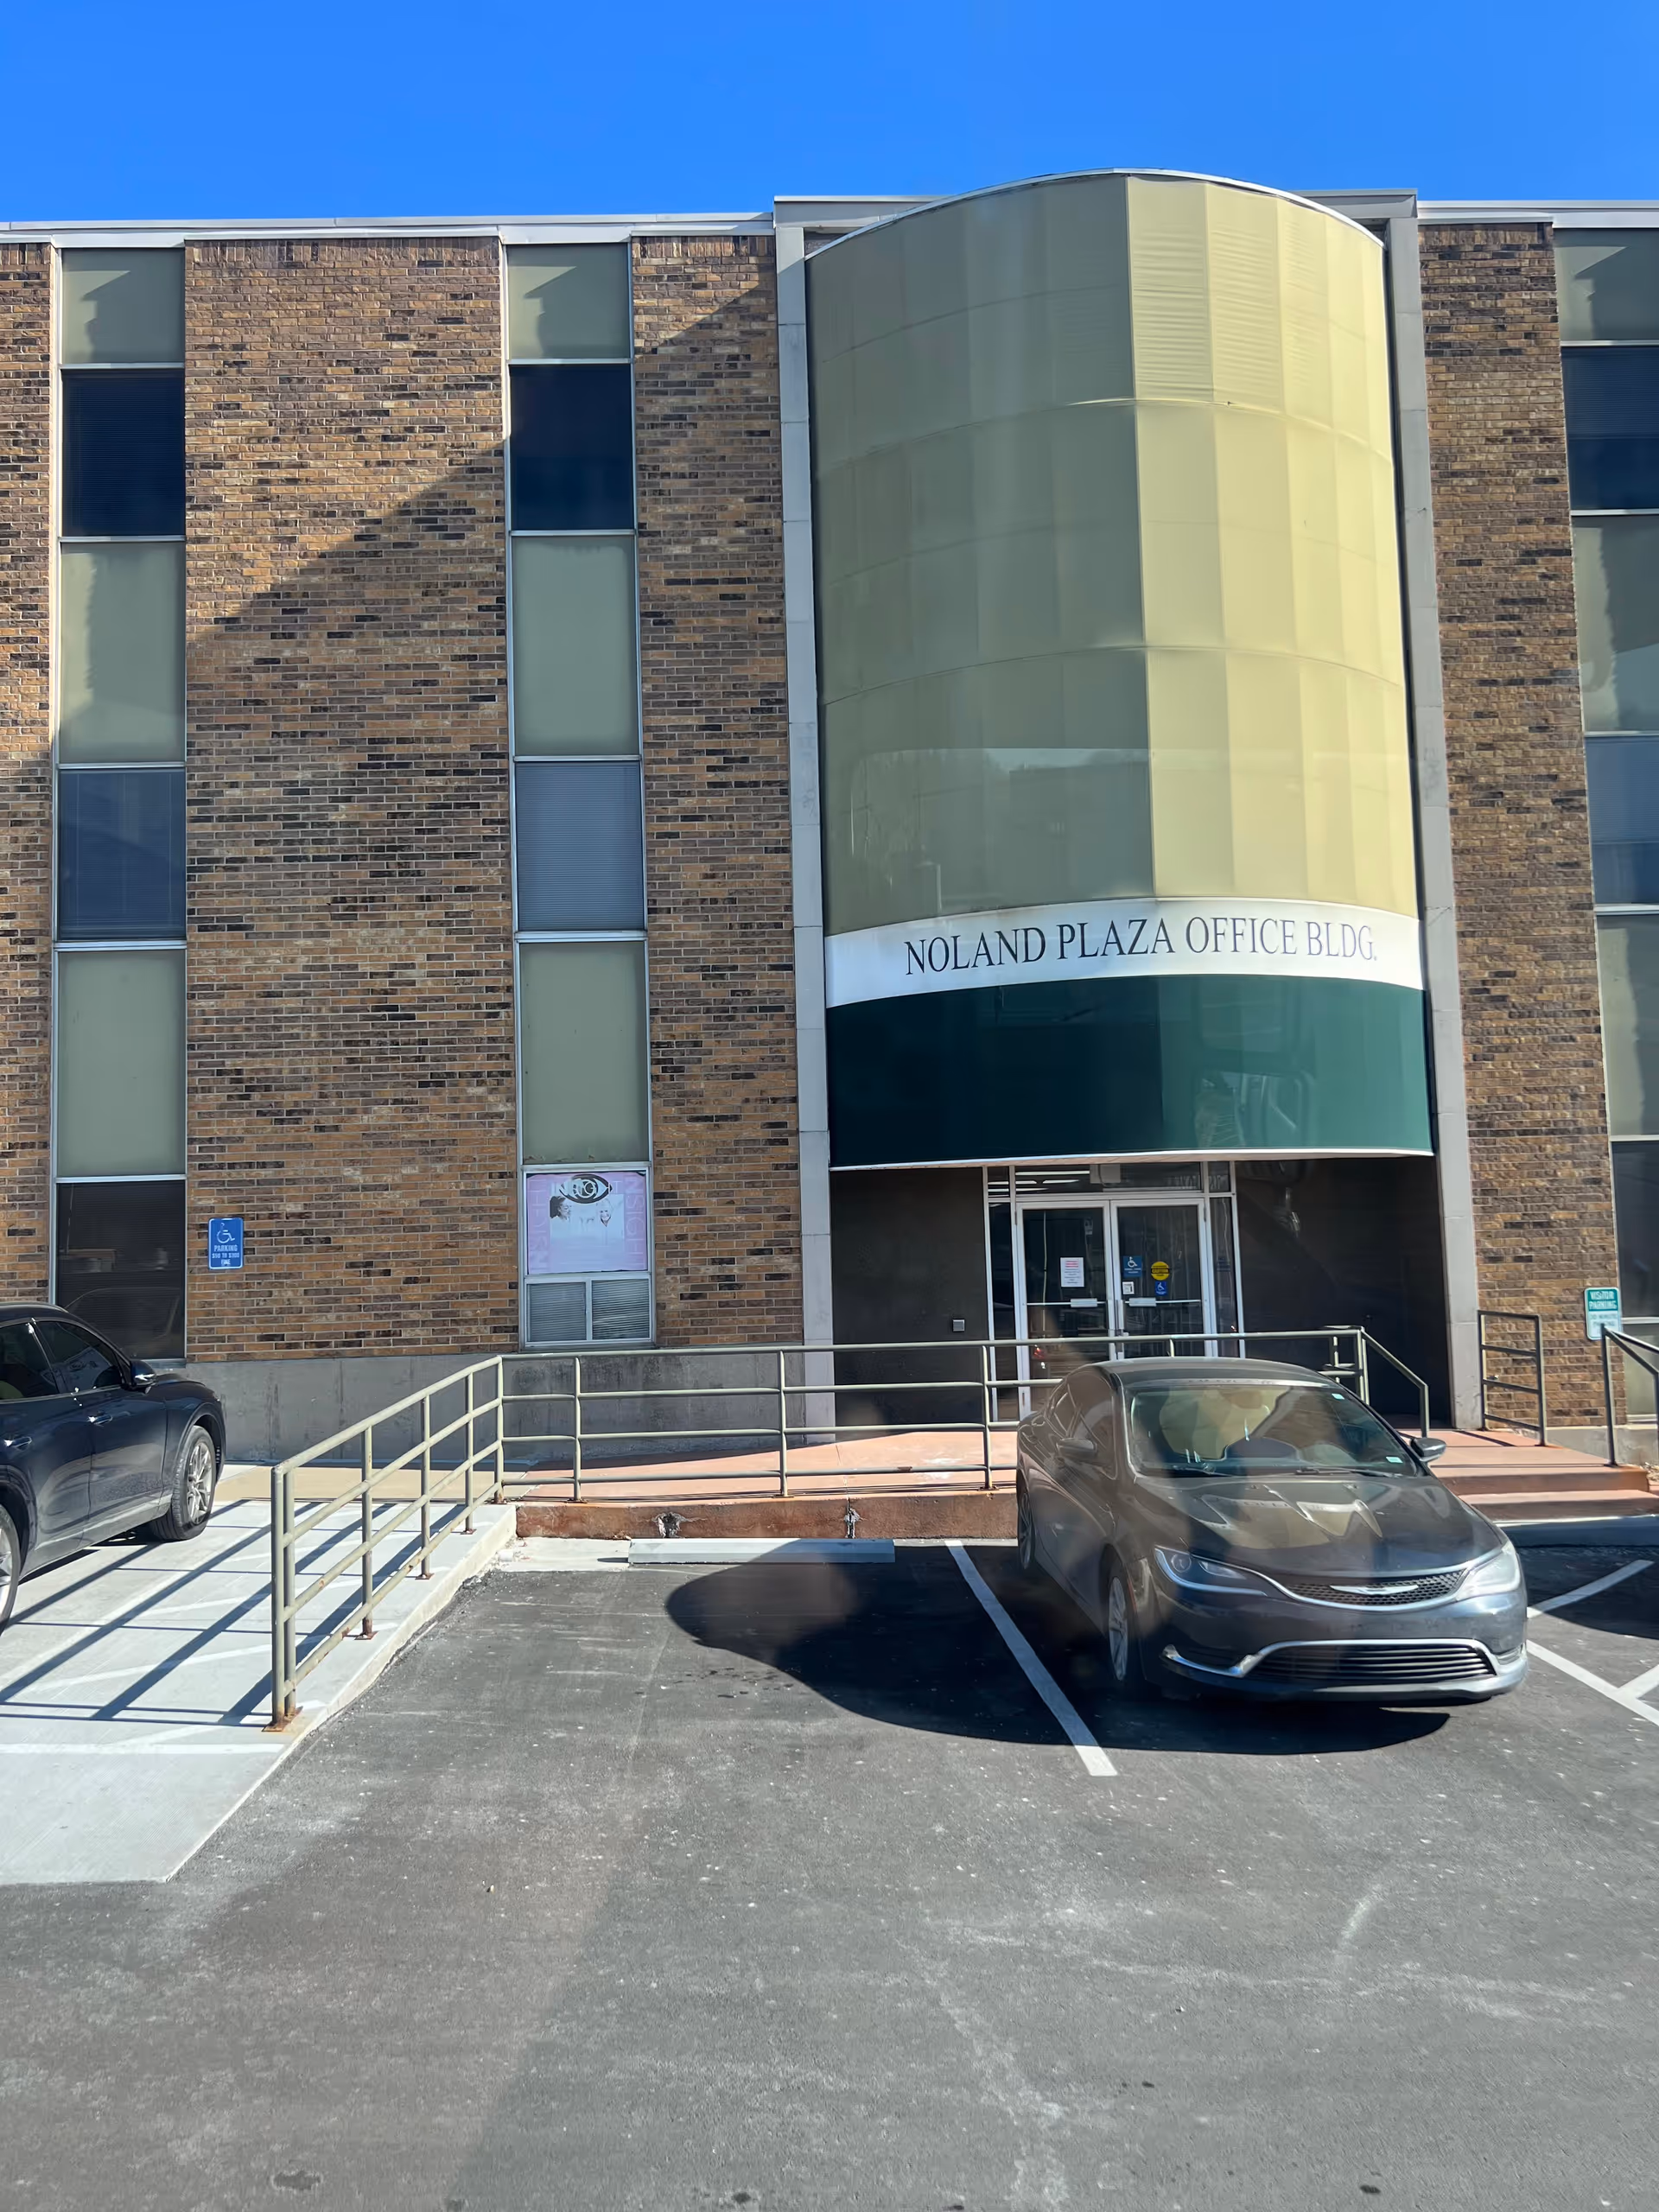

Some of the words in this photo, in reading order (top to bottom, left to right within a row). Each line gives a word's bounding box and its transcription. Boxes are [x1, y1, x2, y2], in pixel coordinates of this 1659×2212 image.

[905, 926, 1046, 976] NOLAND
[1058, 918, 1174, 961] PLAZA
[1185, 916, 1298, 957] OFFICE
[1305, 919, 1377, 963] BLDG.
[1590, 1291, 1615, 1300] VISITOR
[1589, 1300, 1618, 1310] PARKING
